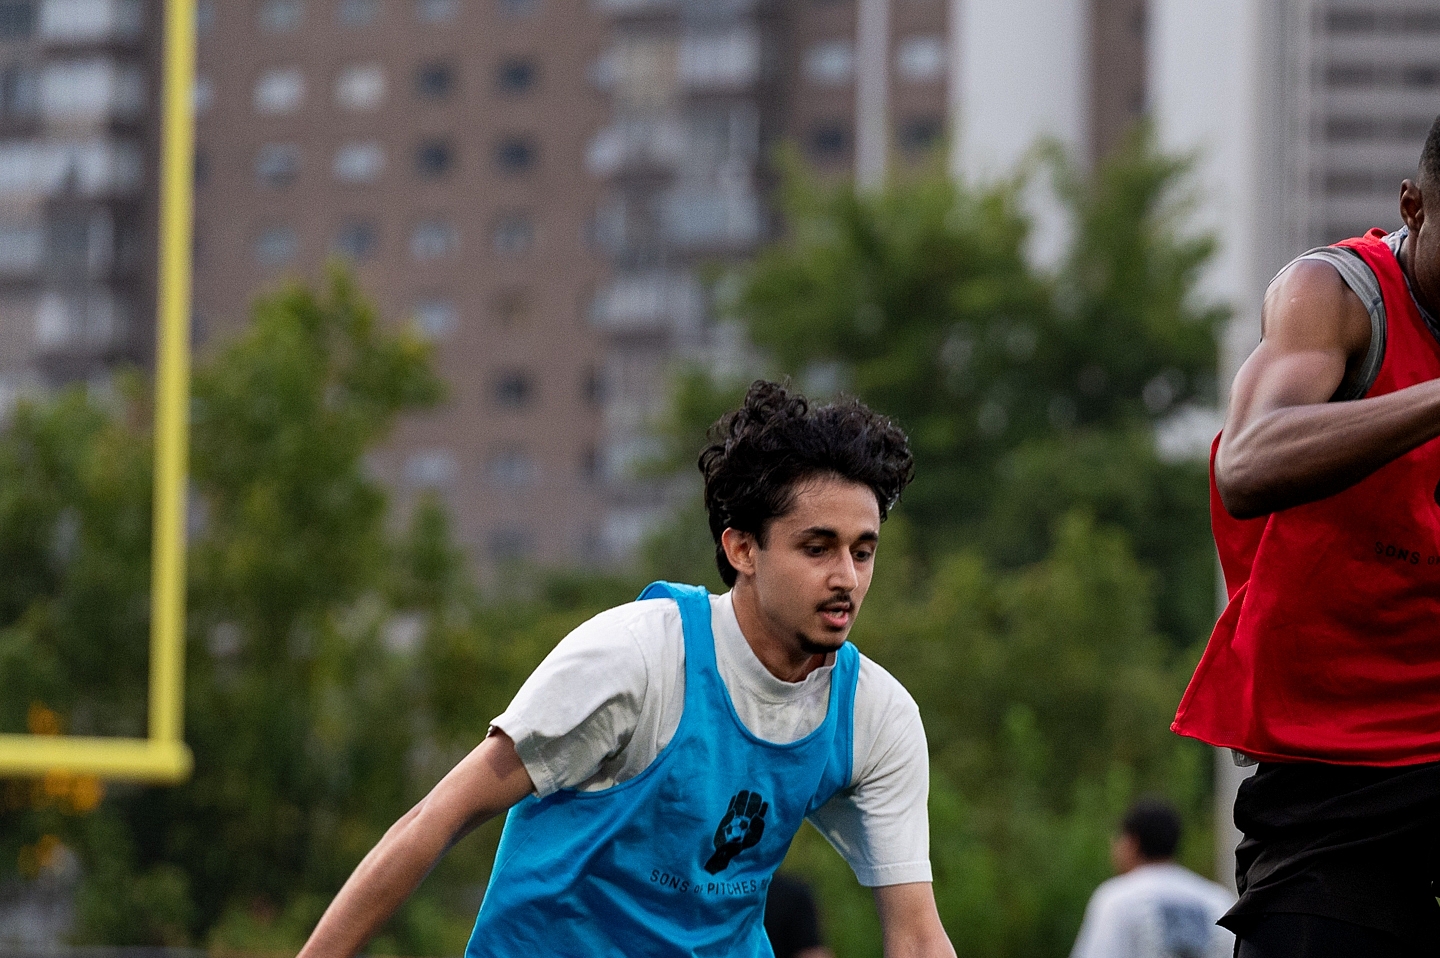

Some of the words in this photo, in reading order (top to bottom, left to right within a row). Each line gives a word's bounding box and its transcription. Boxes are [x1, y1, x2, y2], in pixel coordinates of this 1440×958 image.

[1374, 541, 1421, 565] SONS
[649, 869, 690, 893] SONS
[707, 879, 758, 895] PITCHES
